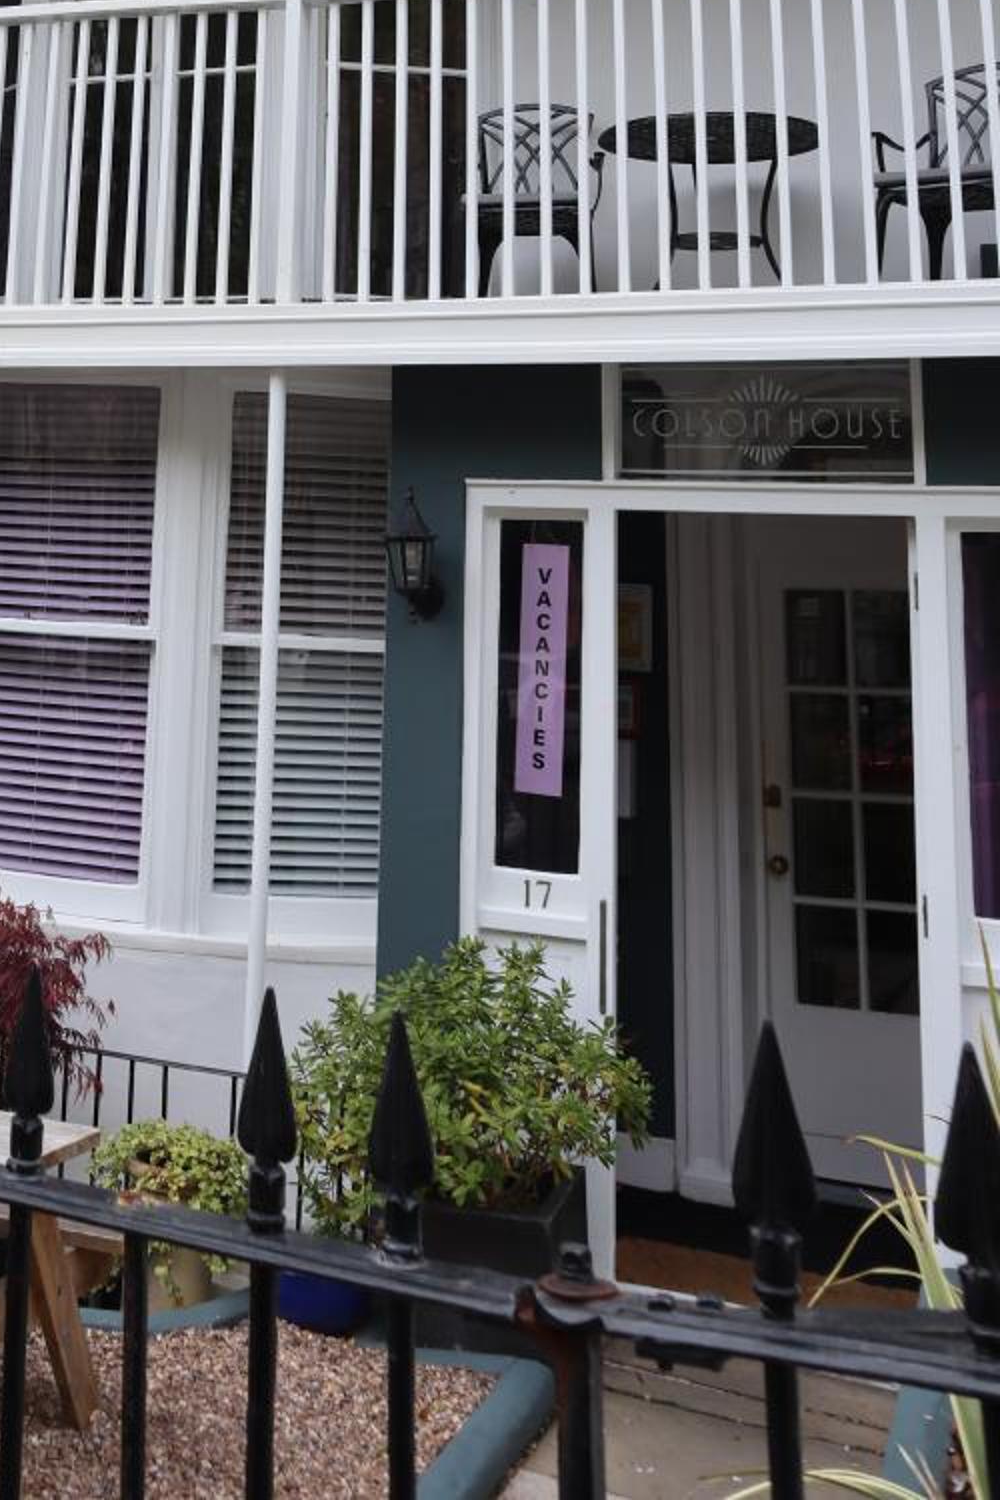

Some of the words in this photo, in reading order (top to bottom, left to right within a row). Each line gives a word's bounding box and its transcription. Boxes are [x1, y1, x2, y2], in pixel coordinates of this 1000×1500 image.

[632, 407, 770, 439] COLSON
[789, 408, 903, 439] HOUSE
[531, 566, 553, 771] VACANCIES
[523, 879, 553, 910] 17
